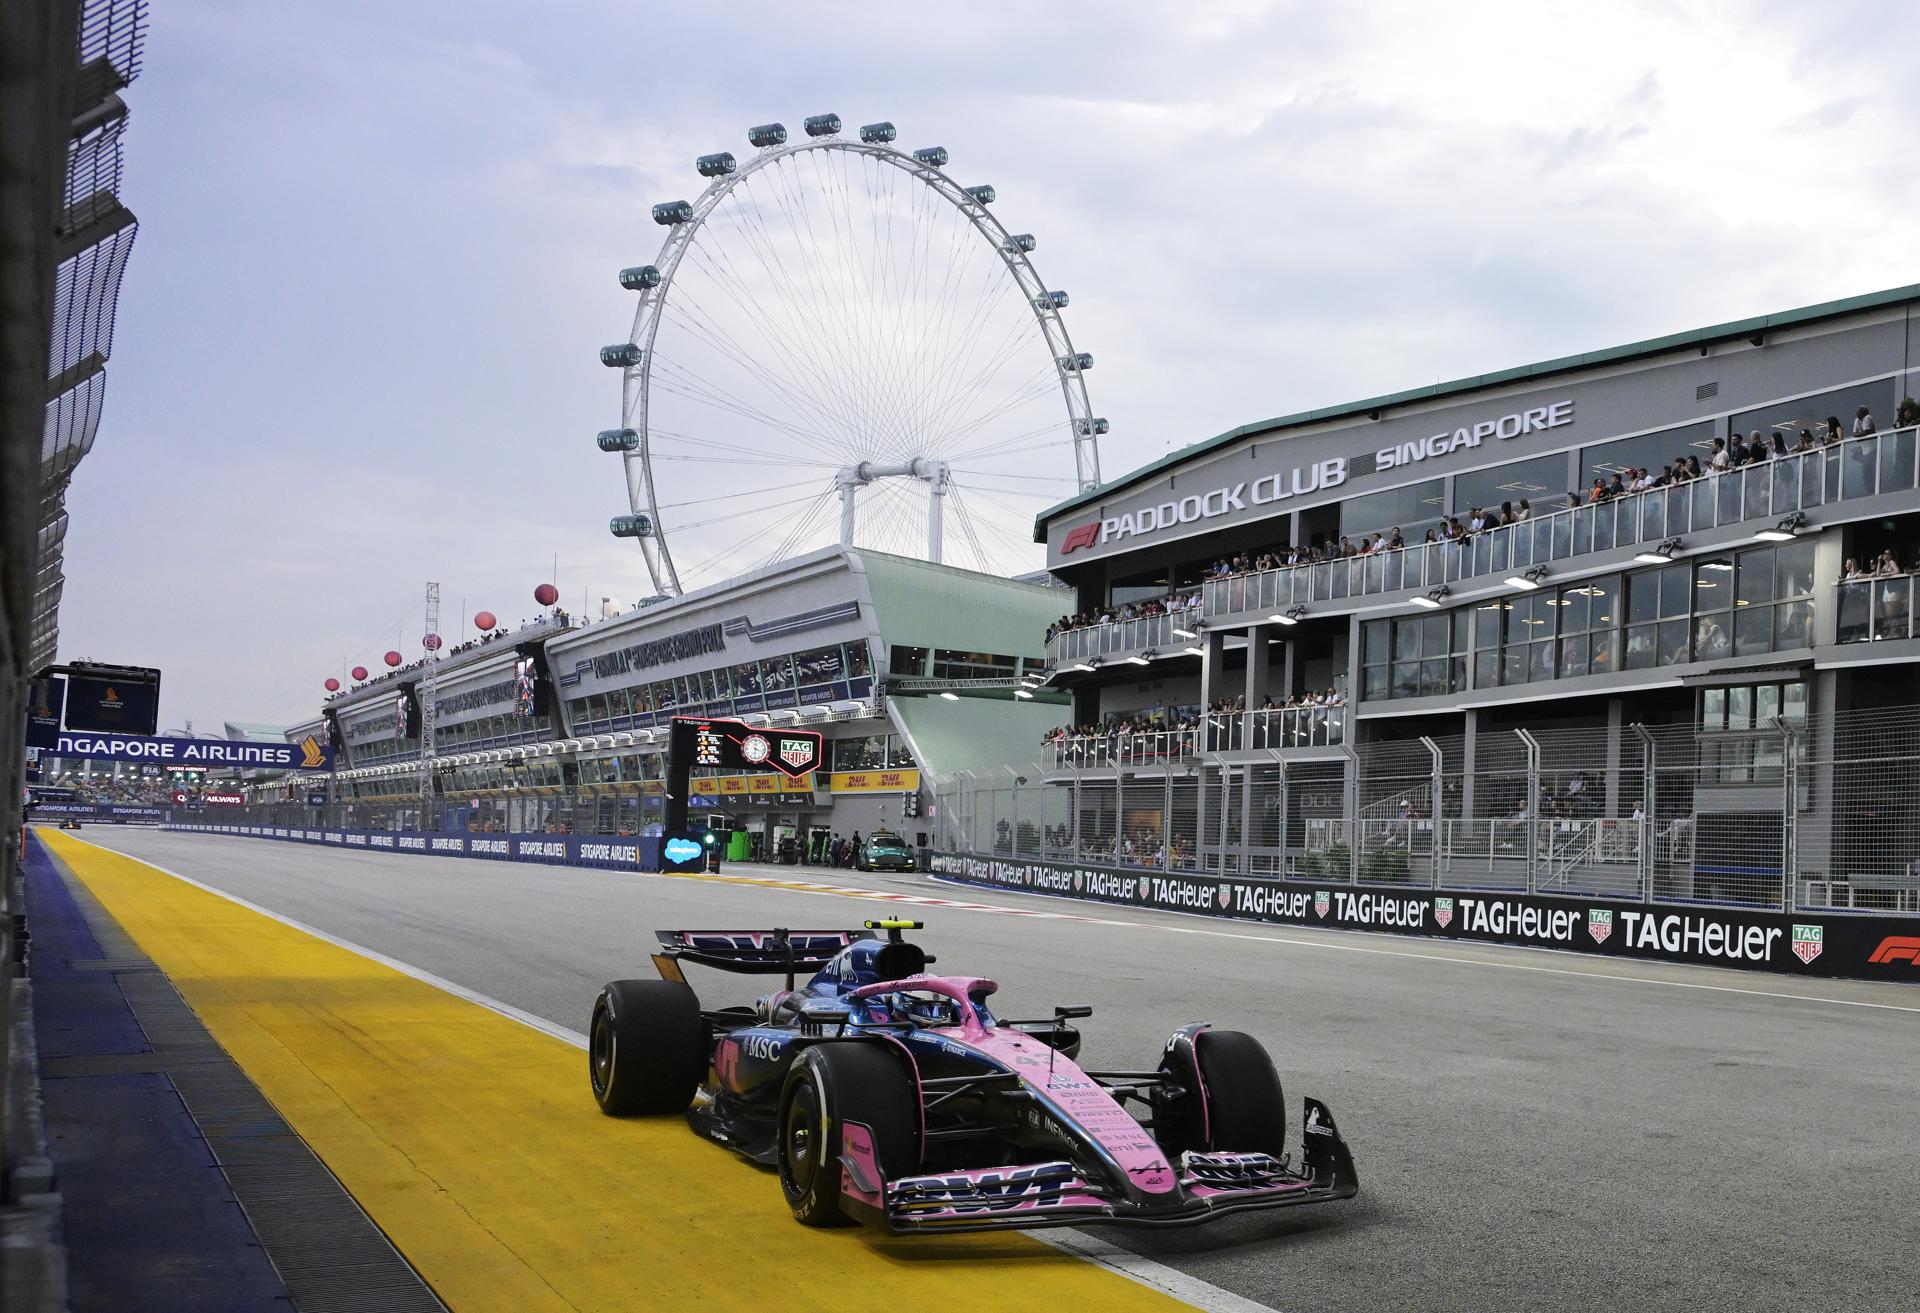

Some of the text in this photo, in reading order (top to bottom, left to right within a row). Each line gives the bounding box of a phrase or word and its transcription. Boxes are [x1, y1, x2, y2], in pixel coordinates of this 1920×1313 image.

[1101, 481, 1248, 543] PADDOCK
[1251, 457, 1347, 505] CLUB
[1375, 400, 1574, 471] SINGAPORE
[57, 737, 291, 763] NGAPORE AIRLINES
[784, 742, 810, 751] TAG
[781, 751, 811, 766] HEUER
[520, 841, 563, 857] SINGAPORE AIRLINES
[581, 844, 635, 861] SINGAPORE AIRLINES
[1316, 892, 1329, 902] TAG
[1437, 899, 1452, 909] TAG
[1591, 912, 1610, 923] TAG
[1590, 924, 1611, 940] HEUER
[1795, 927, 1820, 940] TAG
[1794, 942, 1820, 961] HEUER
[1867, 935, 1920, 966] F
[749, 1035, 781, 1061] MSC
